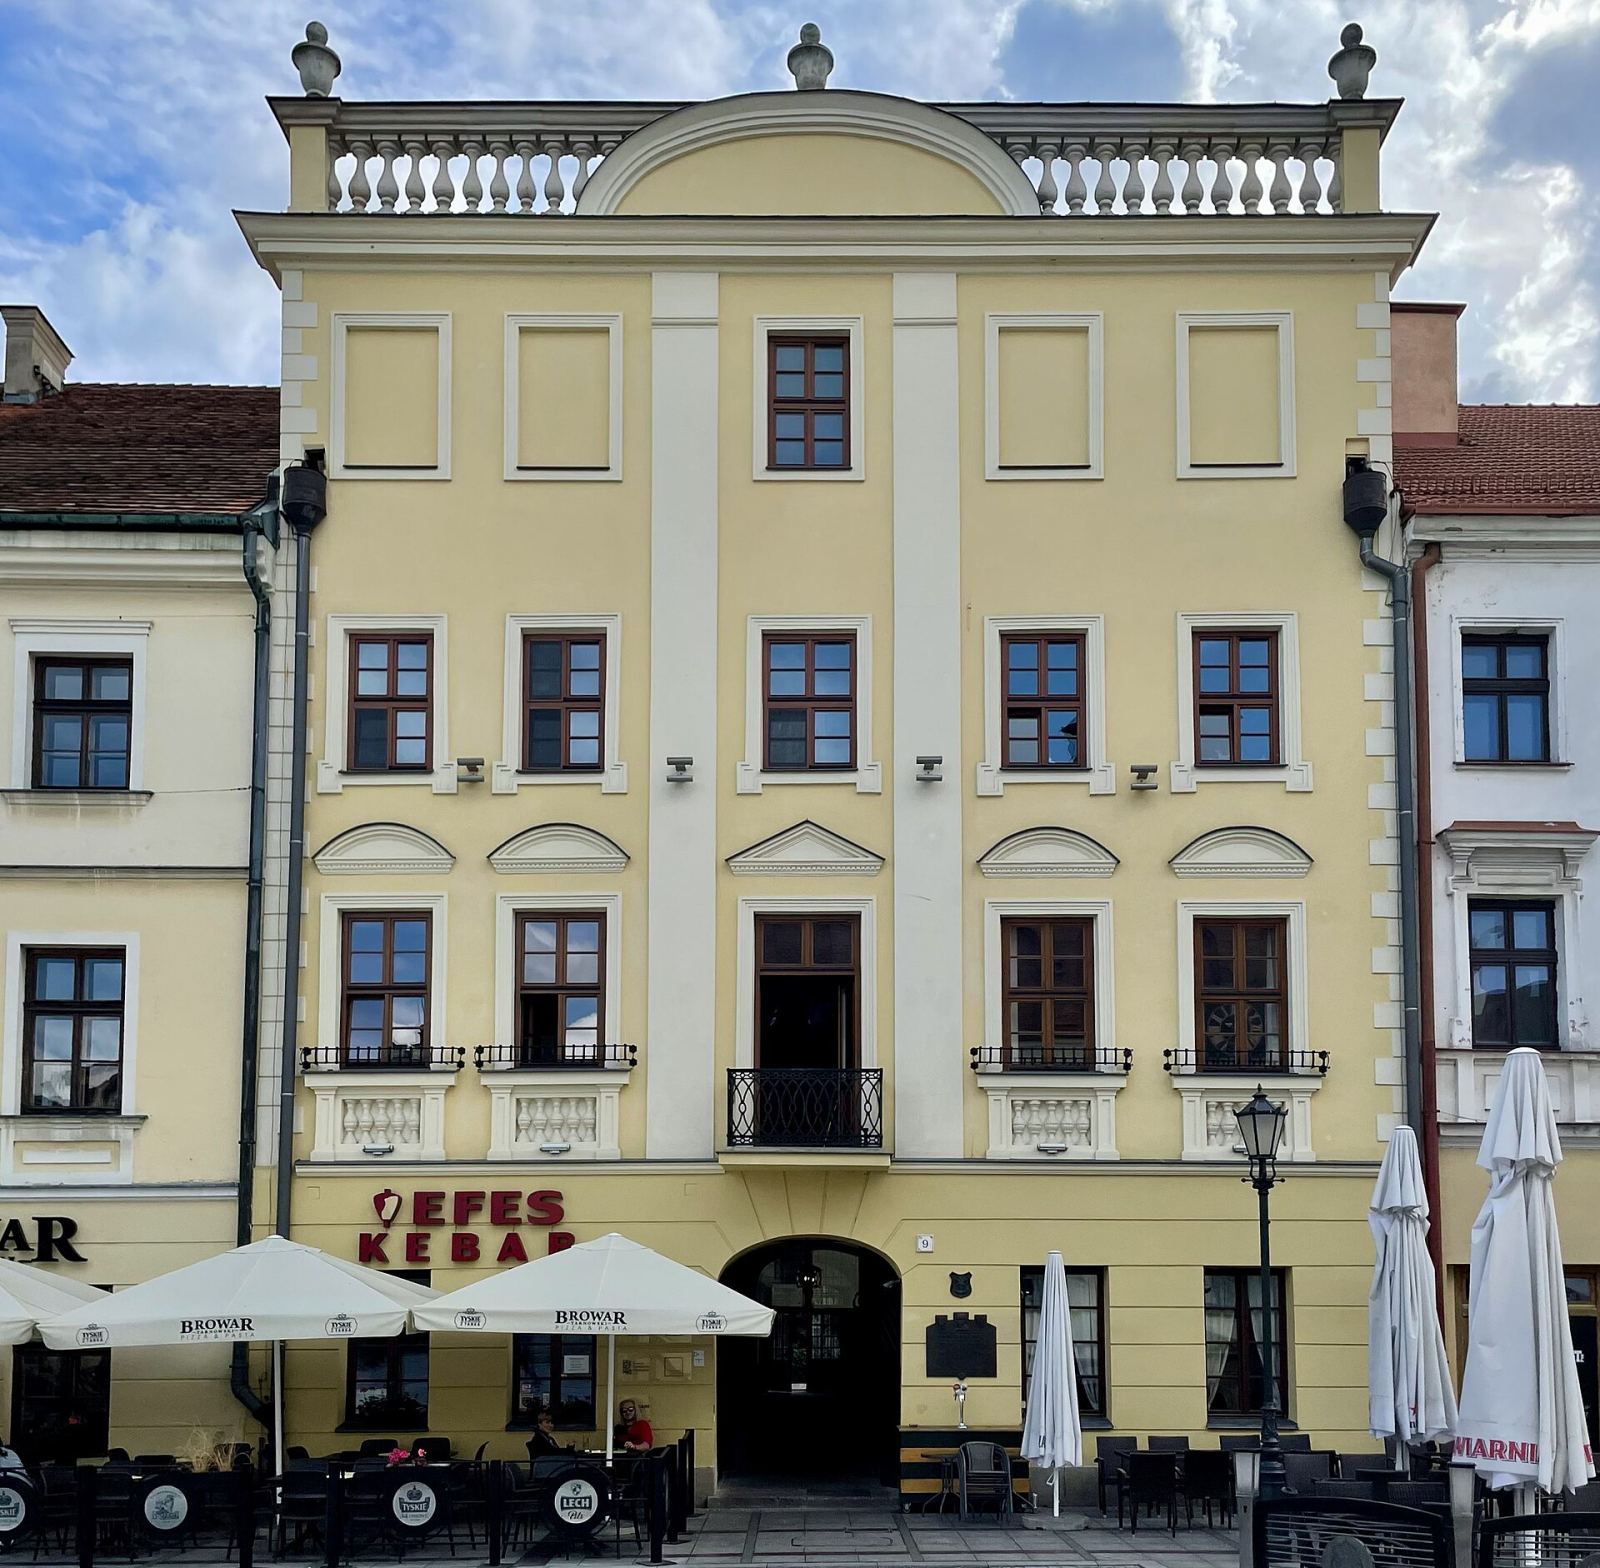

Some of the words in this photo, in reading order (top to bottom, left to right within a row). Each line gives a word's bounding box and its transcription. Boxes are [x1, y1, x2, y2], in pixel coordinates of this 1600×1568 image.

[412, 1190, 565, 1225] EFES
[0, 1216, 88, 1262] AR
[922, 1239, 929, 1249] 9
[555, 1311, 627, 1324] BROWAR
[180, 1318, 255, 1333] BROWAR
[402, 1502, 427, 1511] TYSKIE
[563, 1498, 590, 1508] LECH
